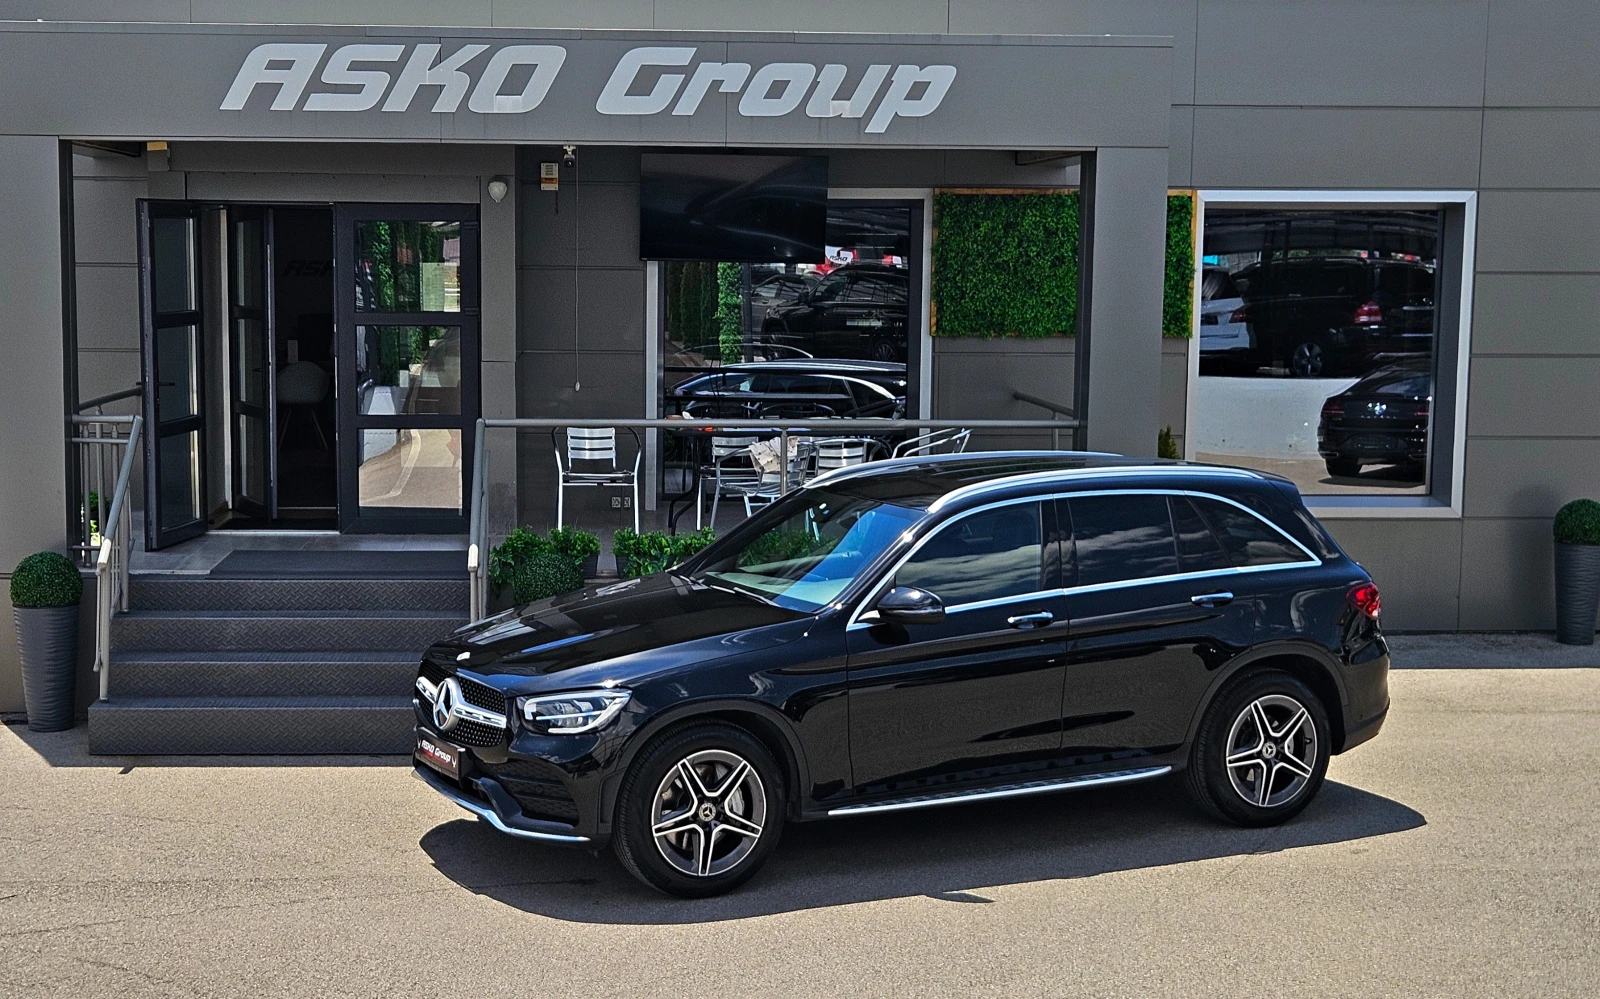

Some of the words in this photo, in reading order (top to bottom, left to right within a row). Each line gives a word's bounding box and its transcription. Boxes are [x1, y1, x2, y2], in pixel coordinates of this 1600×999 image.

[220, 43, 567, 114] ASKO
[596, 46, 957, 134] Group
[421, 739, 435, 754] ASKO
[434, 747, 452, 763] Group
